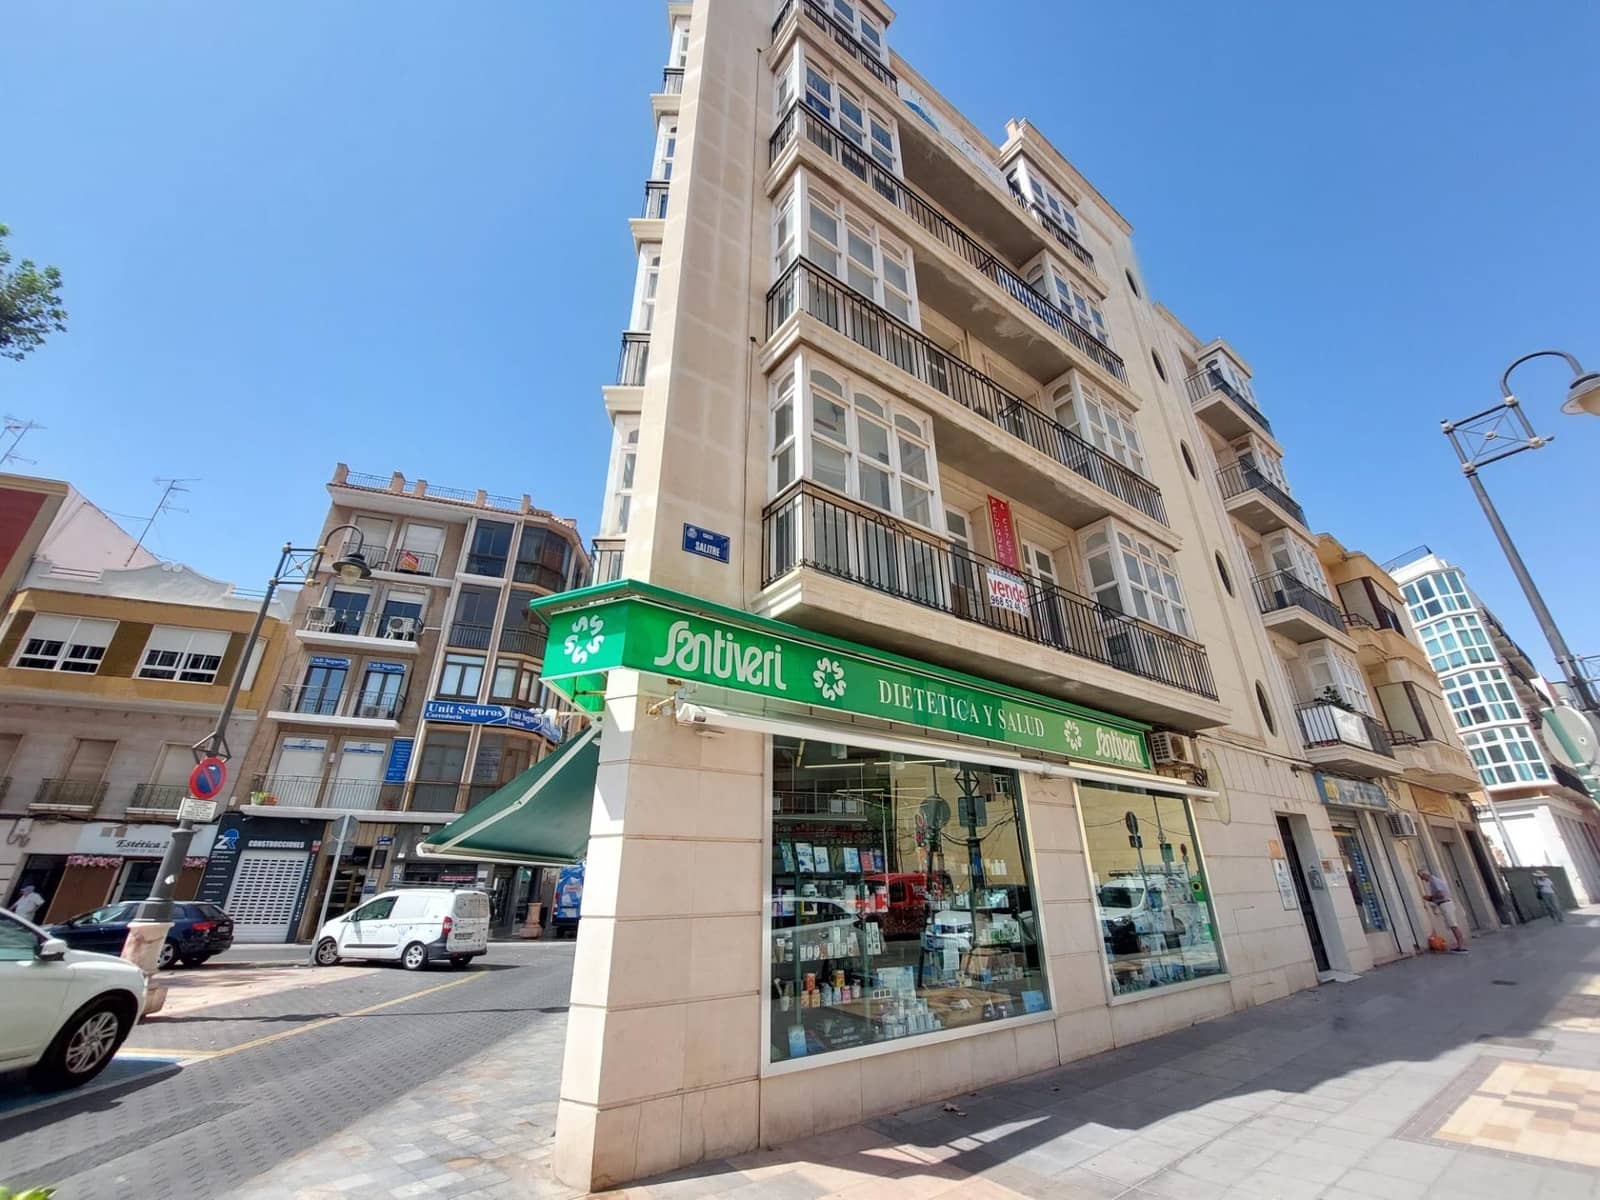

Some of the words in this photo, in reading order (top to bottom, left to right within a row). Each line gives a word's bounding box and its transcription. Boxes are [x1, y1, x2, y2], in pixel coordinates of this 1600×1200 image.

[654, 620, 787, 691] Santiveri
[428, 702, 454, 713] Unit
[457, 704, 503, 717] Seguros
[878, 679, 980, 724] DIETETICA
[983, 705, 994, 727] Y
[998, 708, 1045, 737] SALUD
[1095, 727, 1143, 763] Santiveri
[248, 840, 305, 849] CONSTRUCCIONES
